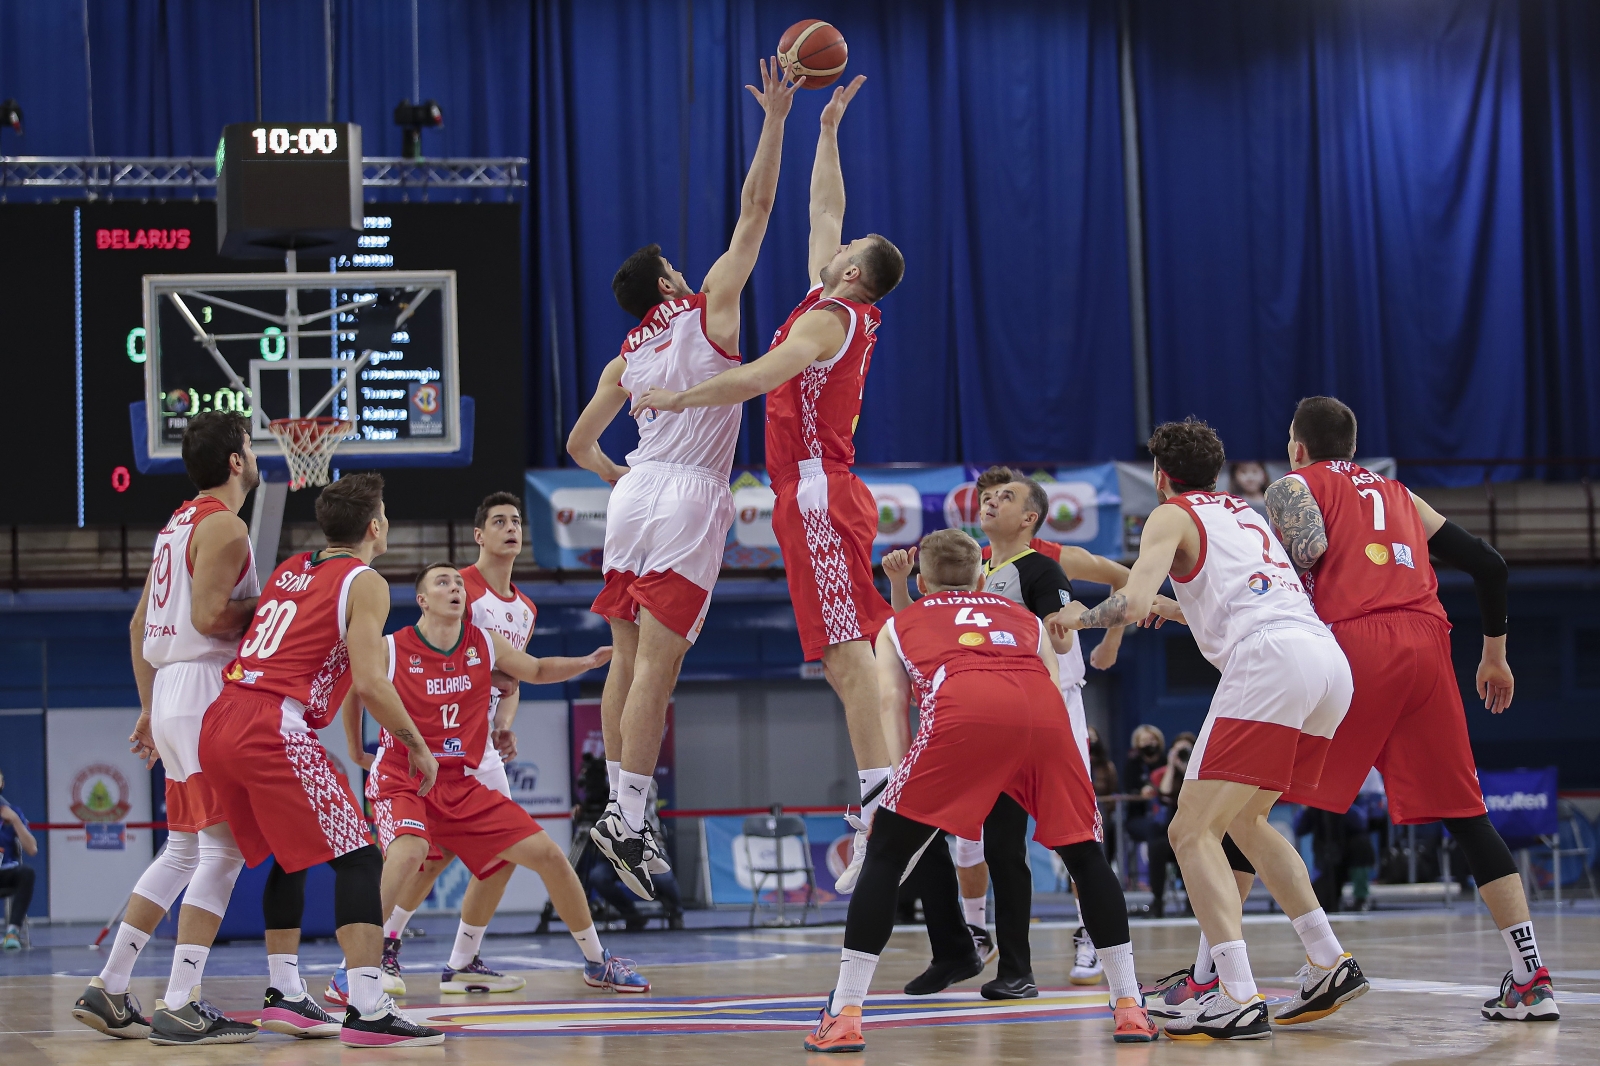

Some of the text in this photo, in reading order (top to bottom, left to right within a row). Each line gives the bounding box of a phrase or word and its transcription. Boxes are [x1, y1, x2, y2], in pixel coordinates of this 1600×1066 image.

[252, 128, 338, 154] 10:00
[96, 228, 191, 250] BELARUS
[627, 298, 691, 351] HALTALI
[259, 326, 286, 361] 0
[111, 465, 131, 493] 0
[1357, 488, 1386, 531] 7
[1237, 519, 1291, 570] 2
[152, 542, 172, 612] 19
[923, 596, 1012, 608] BLIZNIUK
[954, 607, 993, 628] 4
[240, 599, 298, 660] 30
[426, 674, 472, 695] BELARUS
[439, 702, 461, 730] 12
[1509, 926, 1541, 973] ELITE
